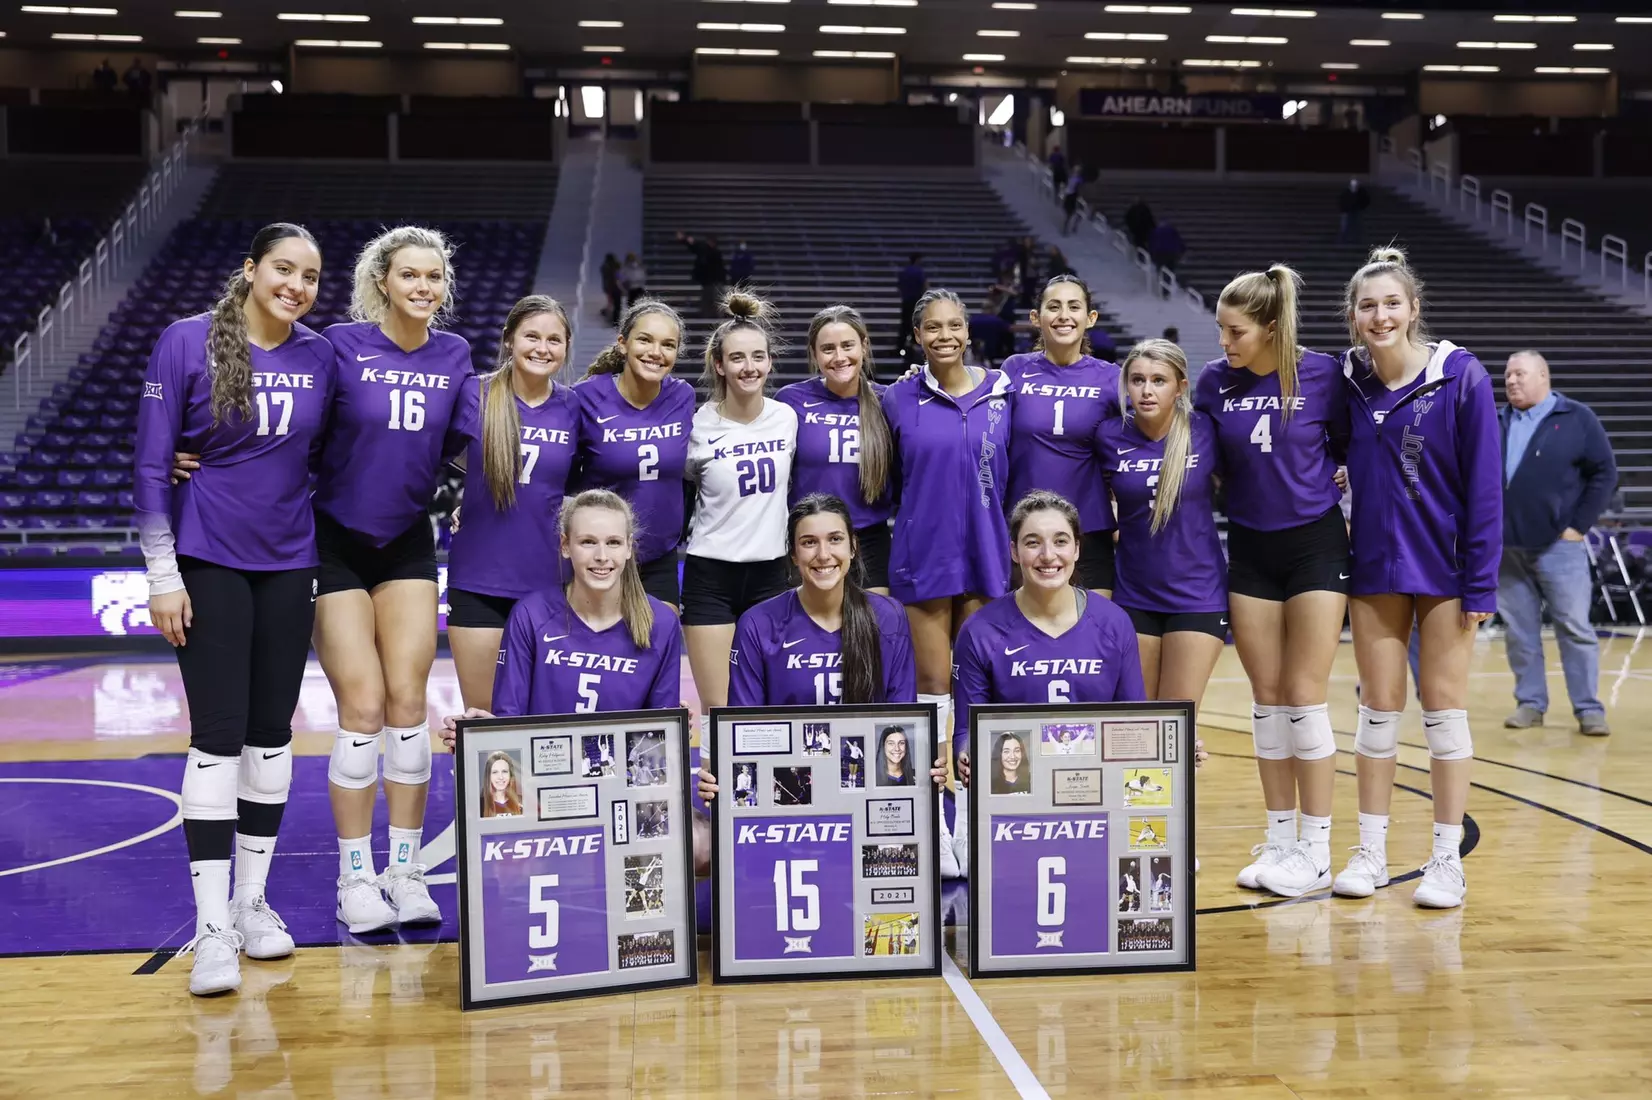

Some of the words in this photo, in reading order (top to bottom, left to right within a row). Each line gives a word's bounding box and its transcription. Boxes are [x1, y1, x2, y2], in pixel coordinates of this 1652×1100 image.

[252, 372, 314, 389] STATE
[361, 367, 449, 389] K-STATE
[1021, 382, 1101, 399] K-STATE
[256, 391, 294, 436] 17
[388, 389, 425, 431] 16
[805, 412, 860, 426] K-STA
[1052, 400, 1065, 435] 1
[521, 426, 570, 444] TATE
[602, 422, 681, 443] K-STATE
[828, 428, 861, 464] 12
[1250, 414, 1272, 452] 4
[637, 443, 658, 481] 2
[714, 439, 786, 460] K-STATE
[1116, 454, 1200, 472] K-STE
[519, 443, 540, 485] 7
[737, 457, 776, 497] 20
[545, 649, 639, 674] K-STATE
[1011, 659, 1102, 676] K-STATE
[575, 673, 602, 713] 5
[737, 822, 852, 844] K-STATE
[994, 820, 1107, 841] K-STATE
[484, 833, 602, 861] K-STATE
[773, 859, 820, 931] 15
[1037, 856, 1066, 926] 6
[529, 874, 559, 949] 5
